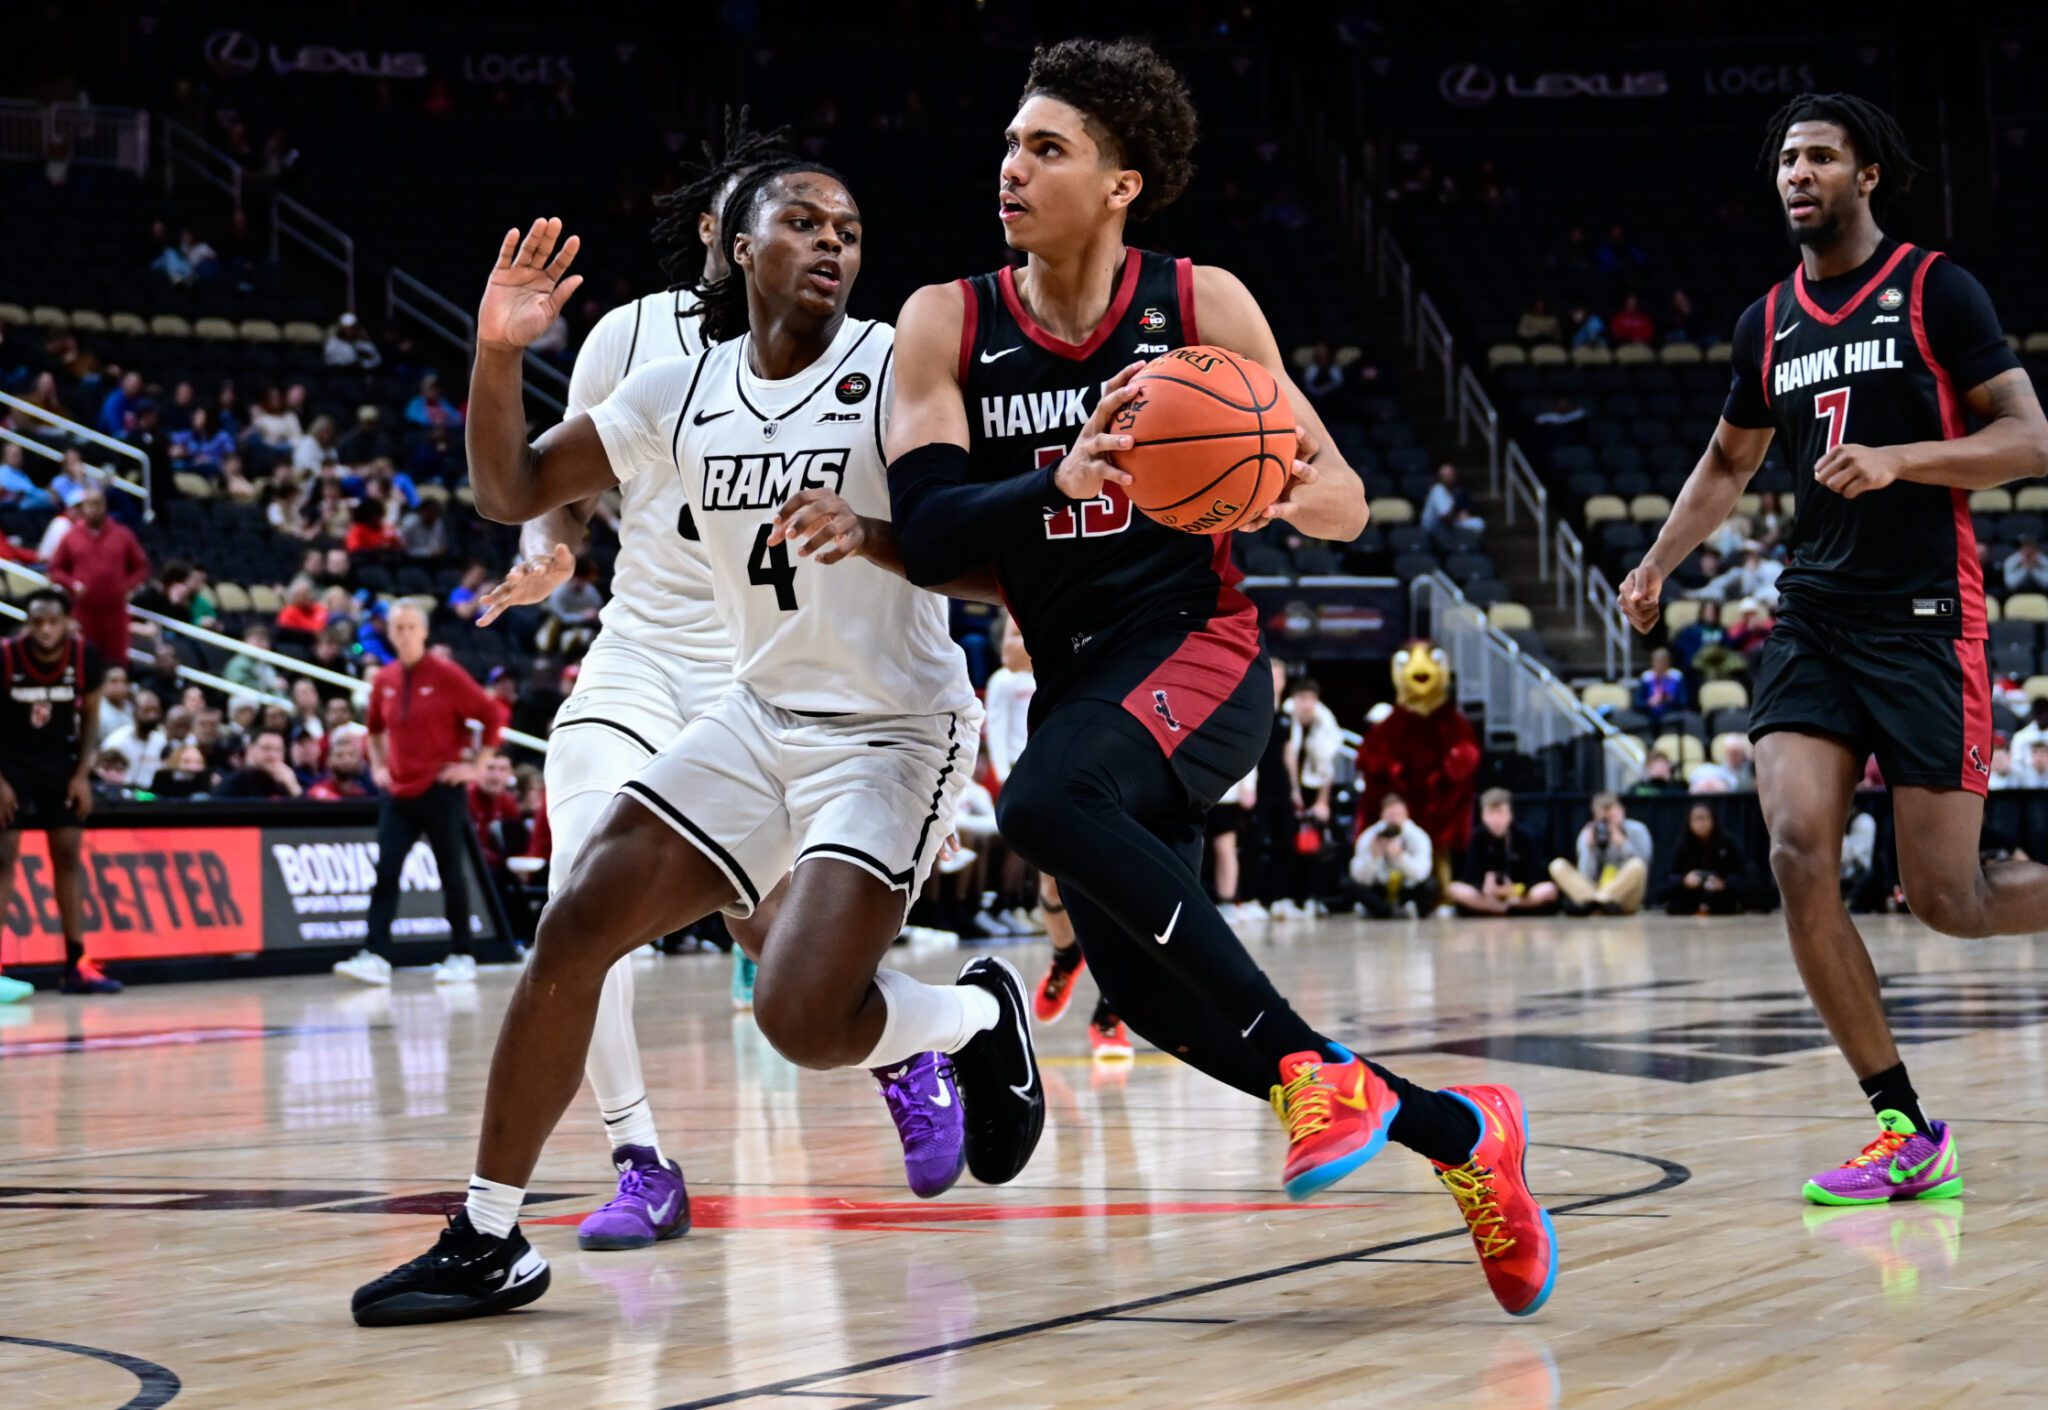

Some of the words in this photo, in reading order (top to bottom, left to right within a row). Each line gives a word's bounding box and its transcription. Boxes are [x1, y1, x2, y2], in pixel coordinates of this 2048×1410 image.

[267, 43, 428, 79] LEXUS
[462, 53, 578, 85] LOGES
[1504, 72, 1670, 98] LEXUS
[1704, 65, 1815, 96] LOGES
[1133, 343, 1169, 354] A10
[1774, 346, 1839, 396] HAWK
[1844, 338, 1904, 375] HILL
[815, 412, 862, 423] A10
[981, 386, 1090, 438] HAWK
[1814, 386, 1851, 454] 7
[702, 447, 851, 511] RAMS
[746, 523, 799, 611] 4
[273, 842, 442, 894] BODYAMO
